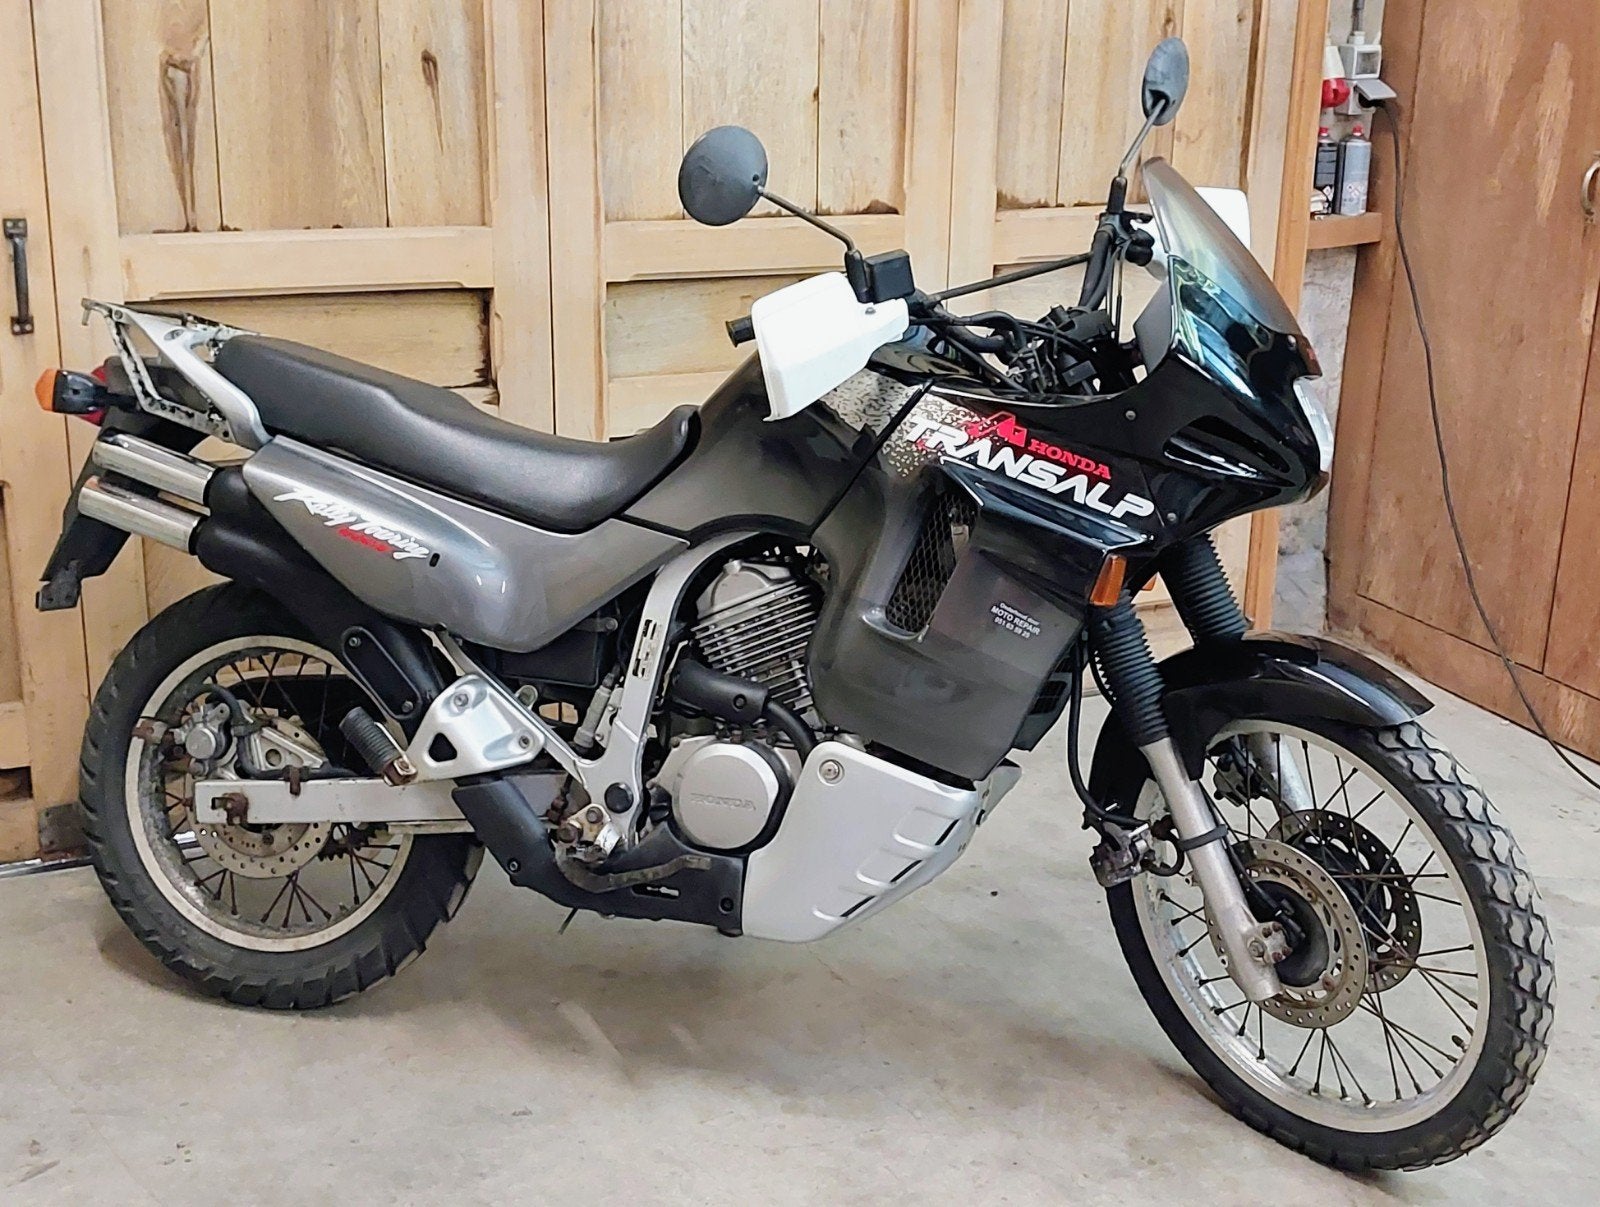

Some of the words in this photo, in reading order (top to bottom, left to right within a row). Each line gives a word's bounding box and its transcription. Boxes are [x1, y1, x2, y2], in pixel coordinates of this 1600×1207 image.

[906, 416, 1155, 519] TRANSALP
[1027, 438, 1112, 480] HONDA
[991, 606, 1013, 621] MOTO
[1013, 618, 1040, 635] REPAIR
